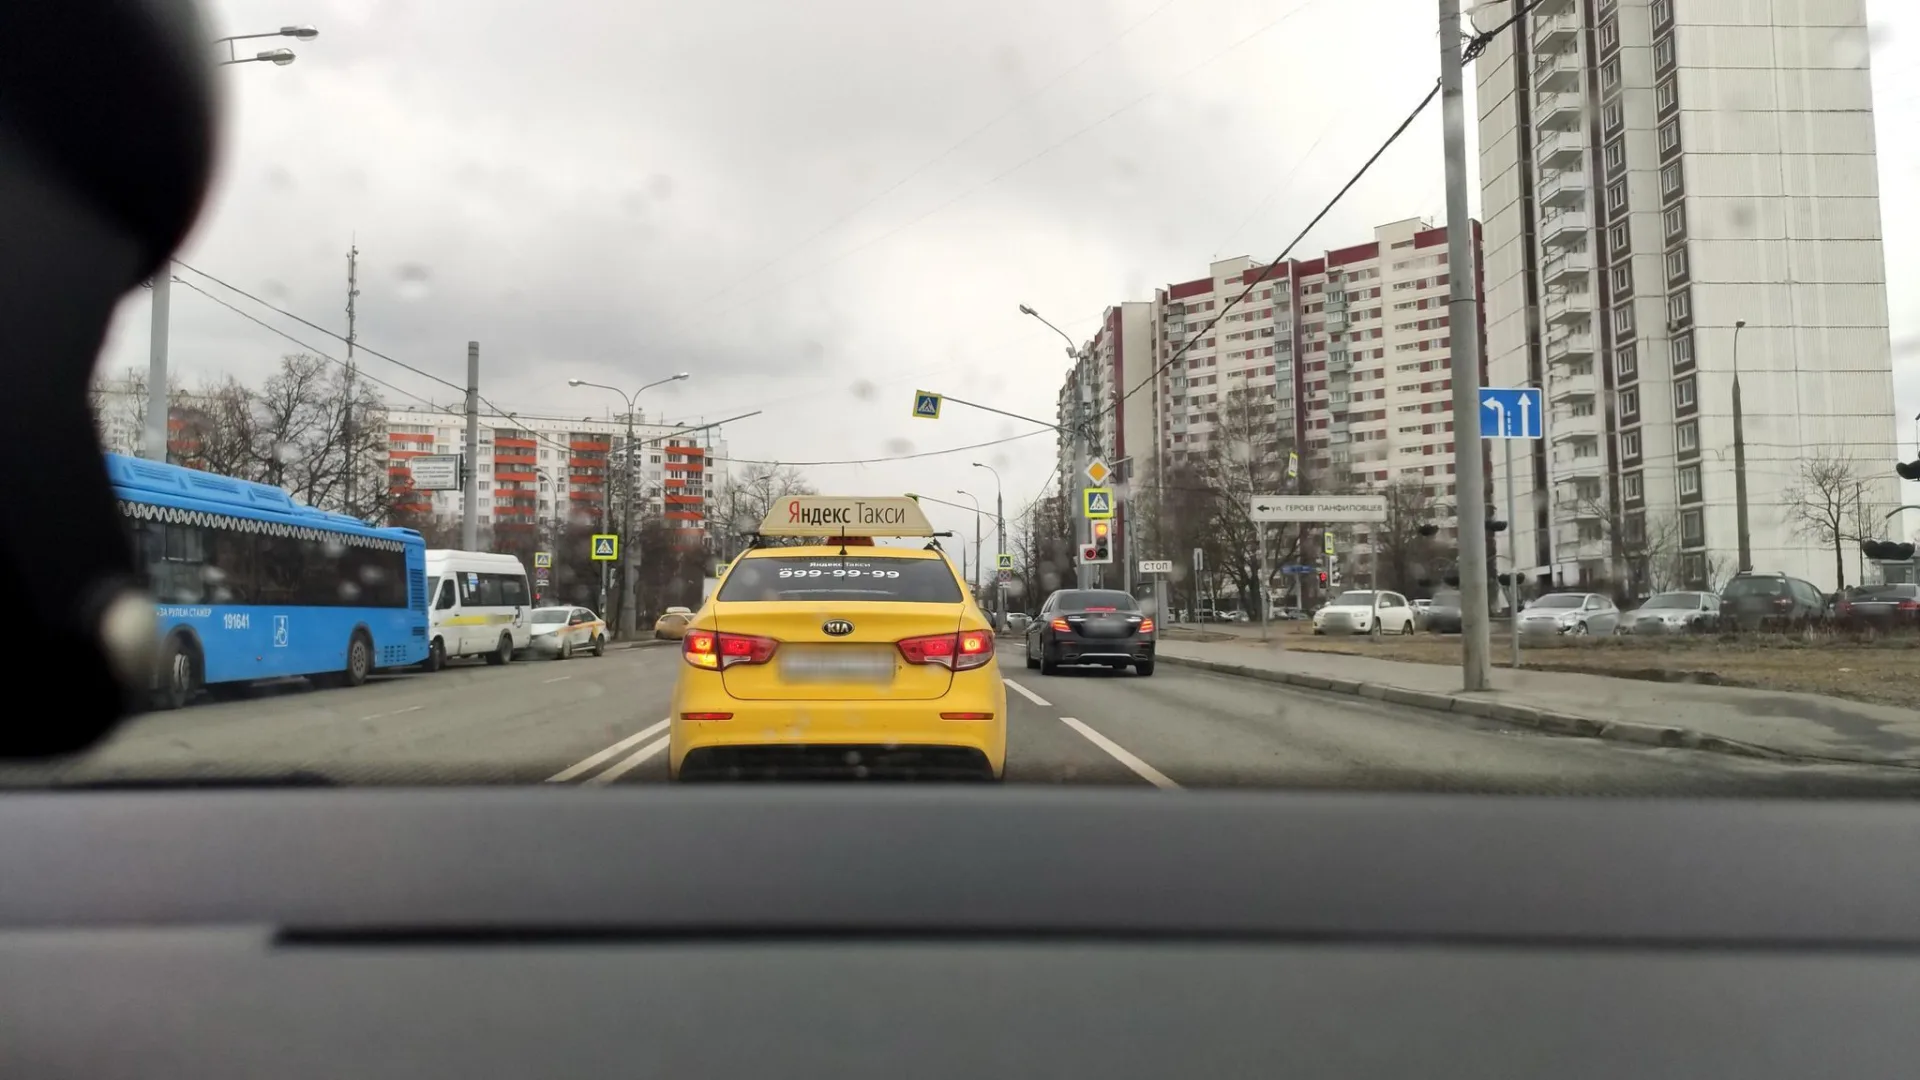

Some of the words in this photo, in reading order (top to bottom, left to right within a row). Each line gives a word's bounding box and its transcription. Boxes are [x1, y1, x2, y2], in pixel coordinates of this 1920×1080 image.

[788, 500, 851, 526] Яндекс
[855, 501, 905, 524] Такси
[1285, 504, 1315, 512] ГЕРОЕВ
[1317, 504, 1383, 512] ПАНФИЛОВЦЕВ
[1143, 562, 1168, 571] СТОП
[779, 569, 900, 579] 999-99-99
[223, 613, 250, 630] 191641
[827, 623, 849, 633] KIA
